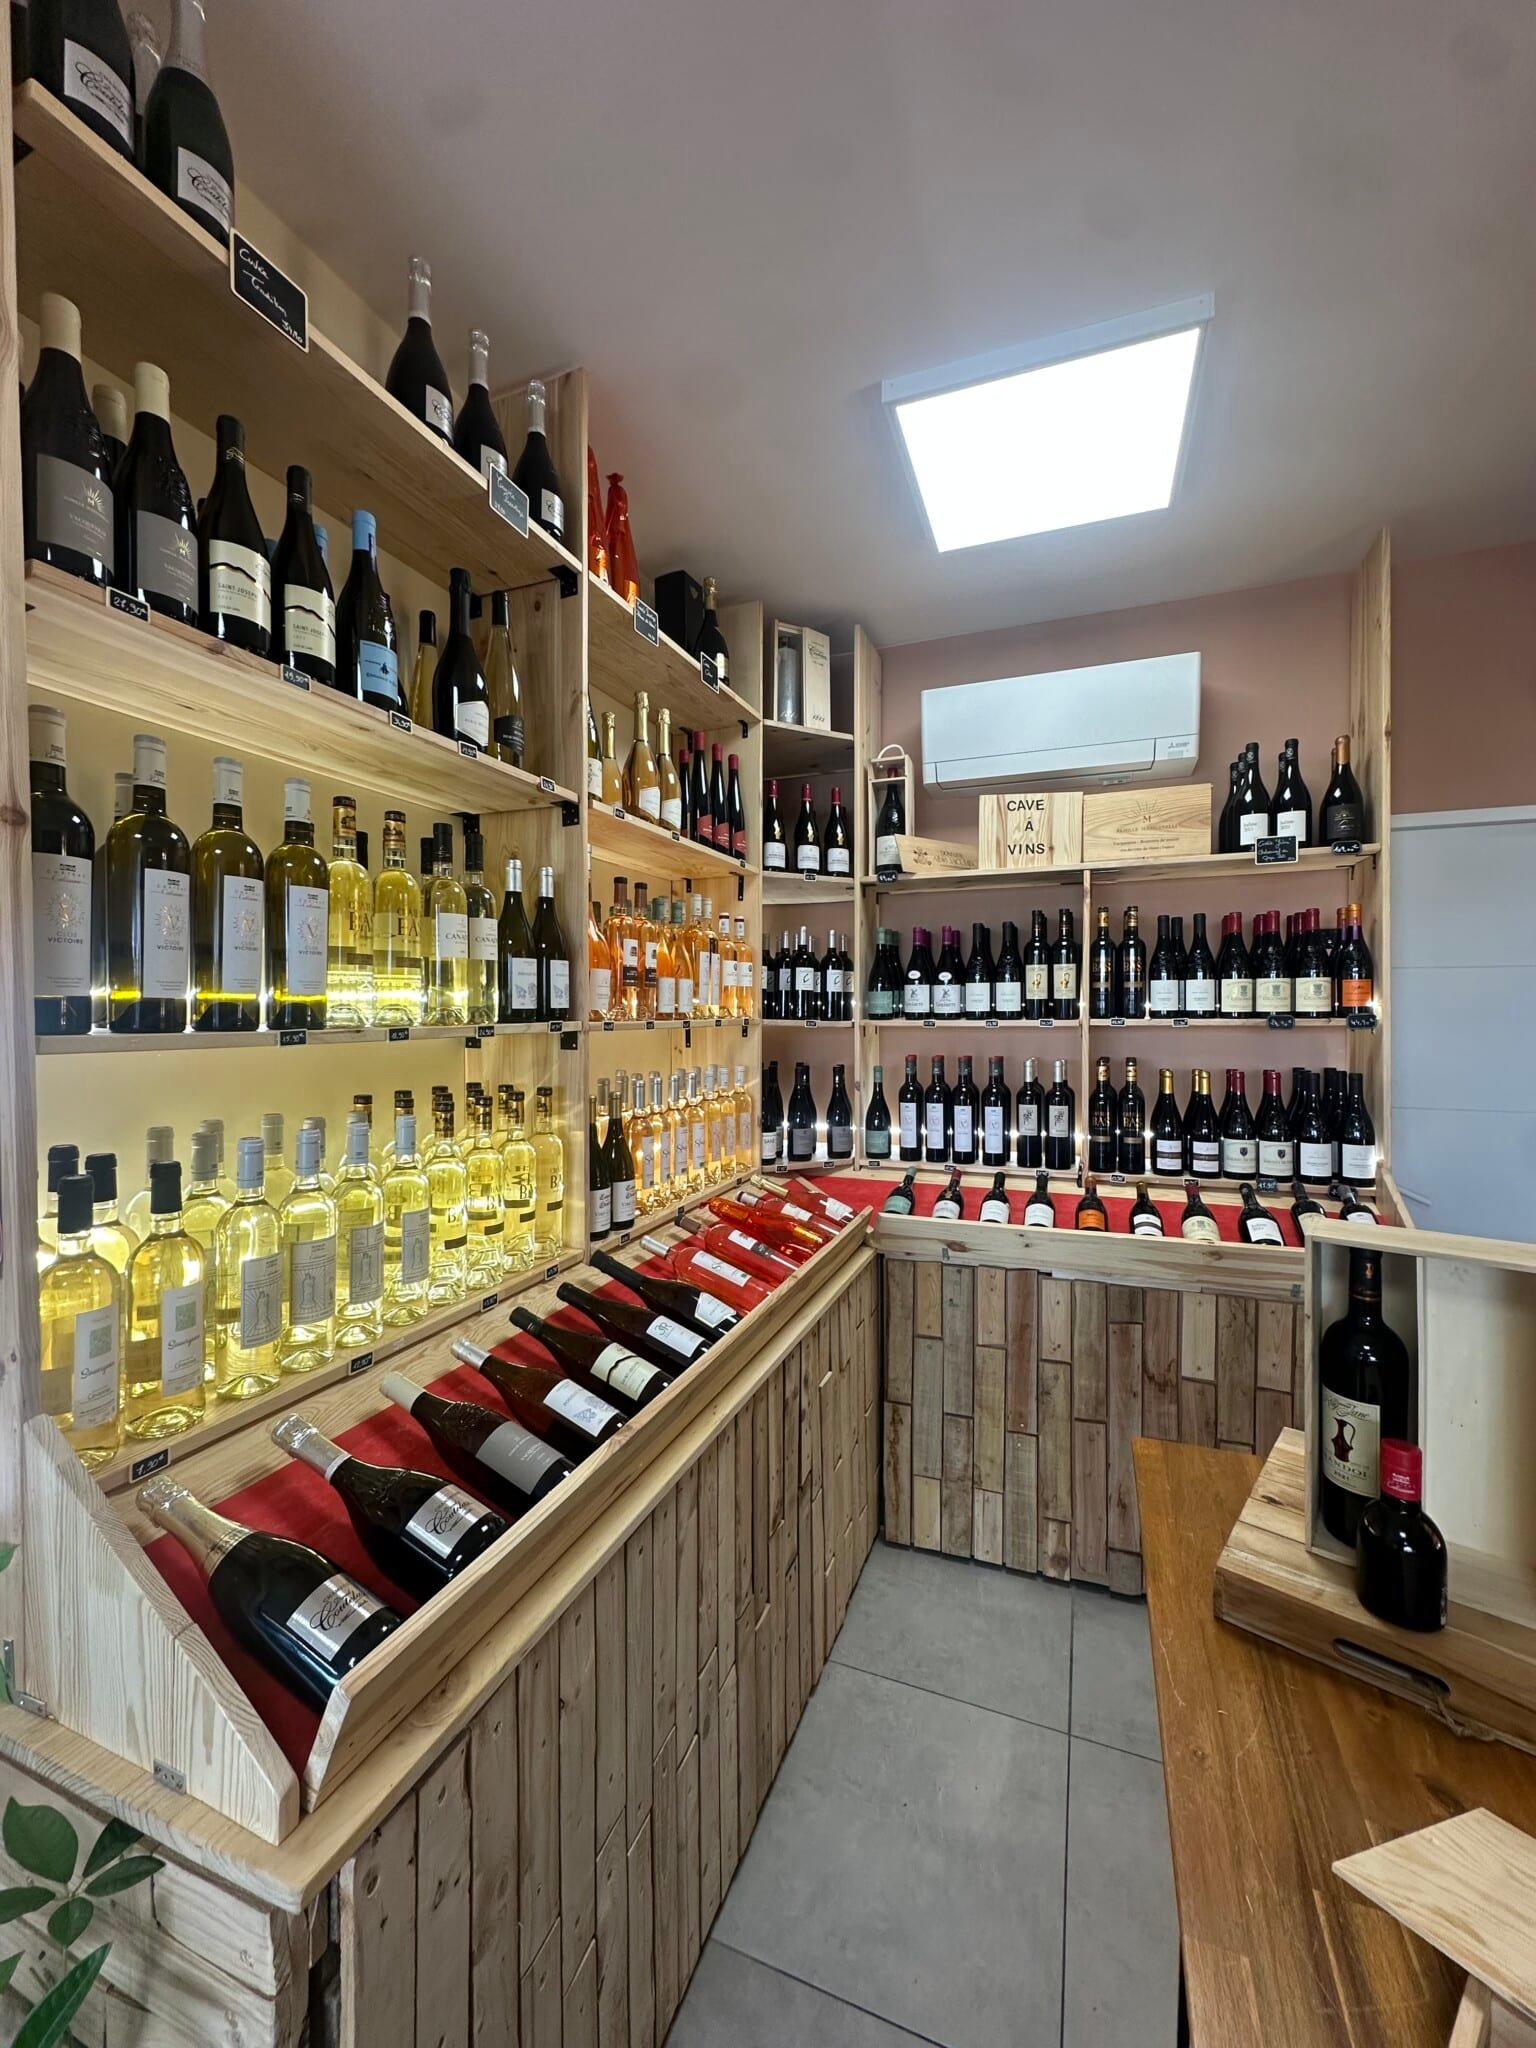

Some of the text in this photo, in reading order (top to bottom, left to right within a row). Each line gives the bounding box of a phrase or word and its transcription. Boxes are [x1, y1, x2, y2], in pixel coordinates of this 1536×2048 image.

[217, 582, 236, 593] SAINT
[1007, 799, 1045, 811] CAVE
[1007, 843, 1045, 855] VINS
[47, 936, 84, 945] VICTOIRE
